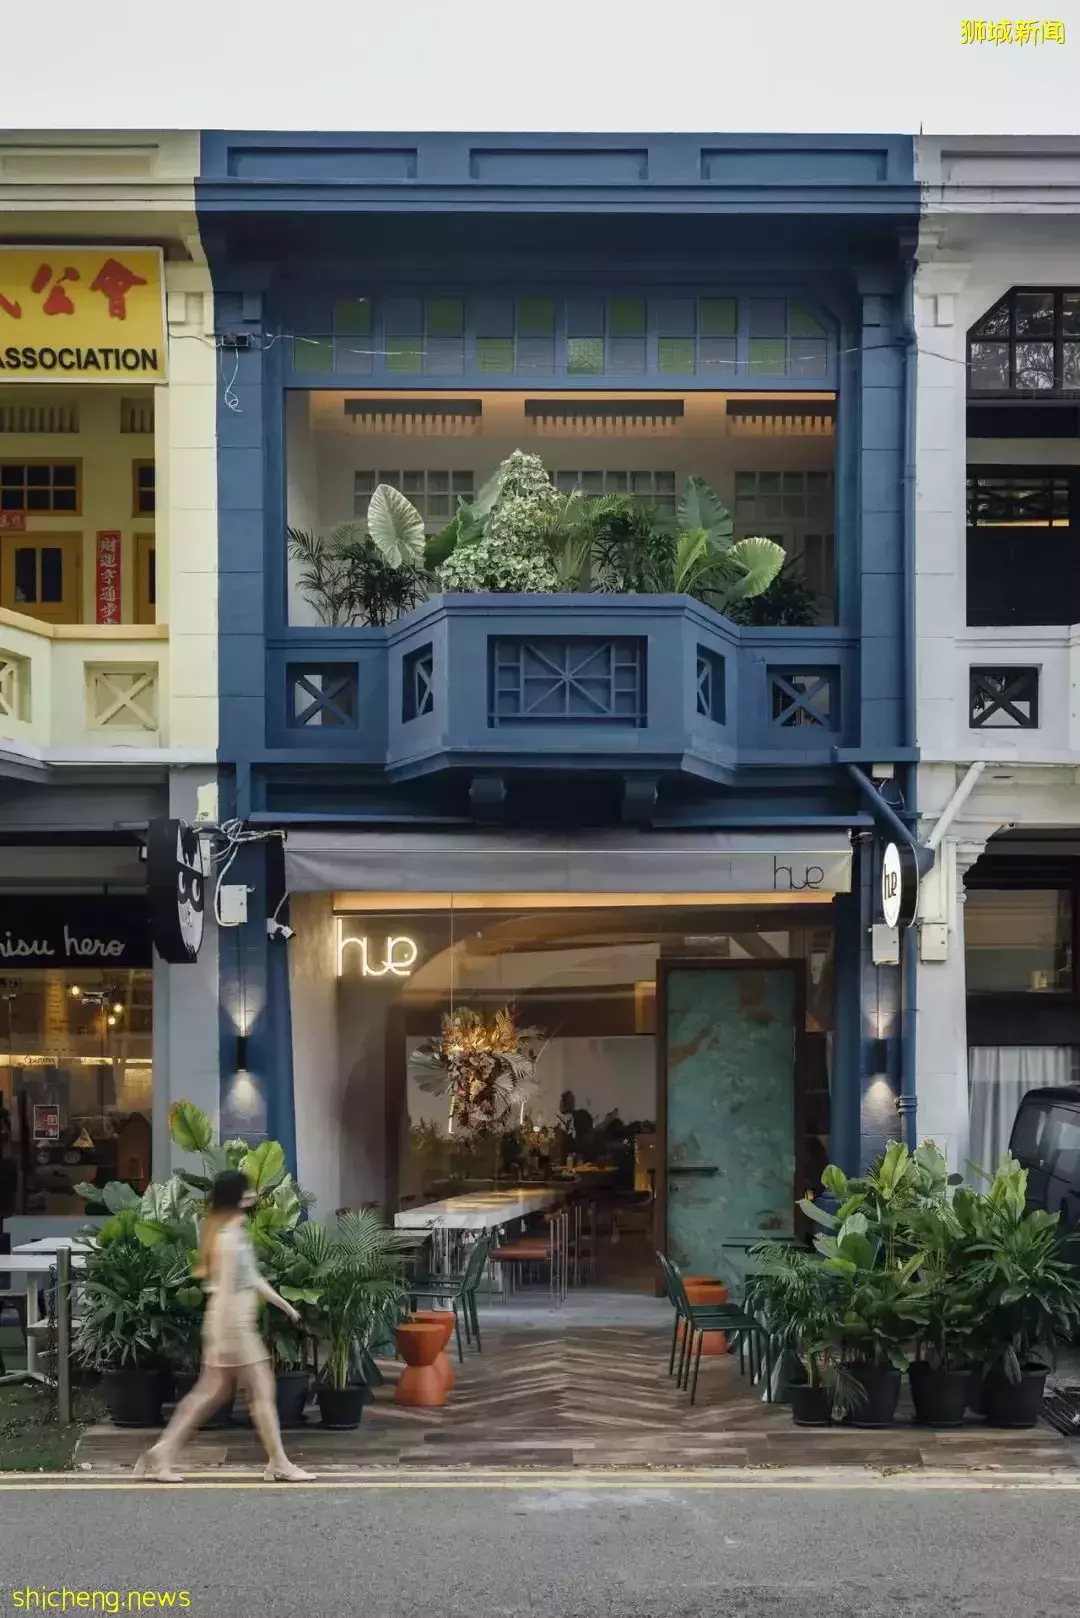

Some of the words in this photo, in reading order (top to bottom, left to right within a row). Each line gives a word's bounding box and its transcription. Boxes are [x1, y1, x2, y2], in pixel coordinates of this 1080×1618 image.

[0, 347, 158, 371] SSOCIATION
[773, 855, 824, 890] hue
[883, 864, 897, 900] hue
[63, 924, 125, 957] hero
[337, 918, 418, 976] hue
